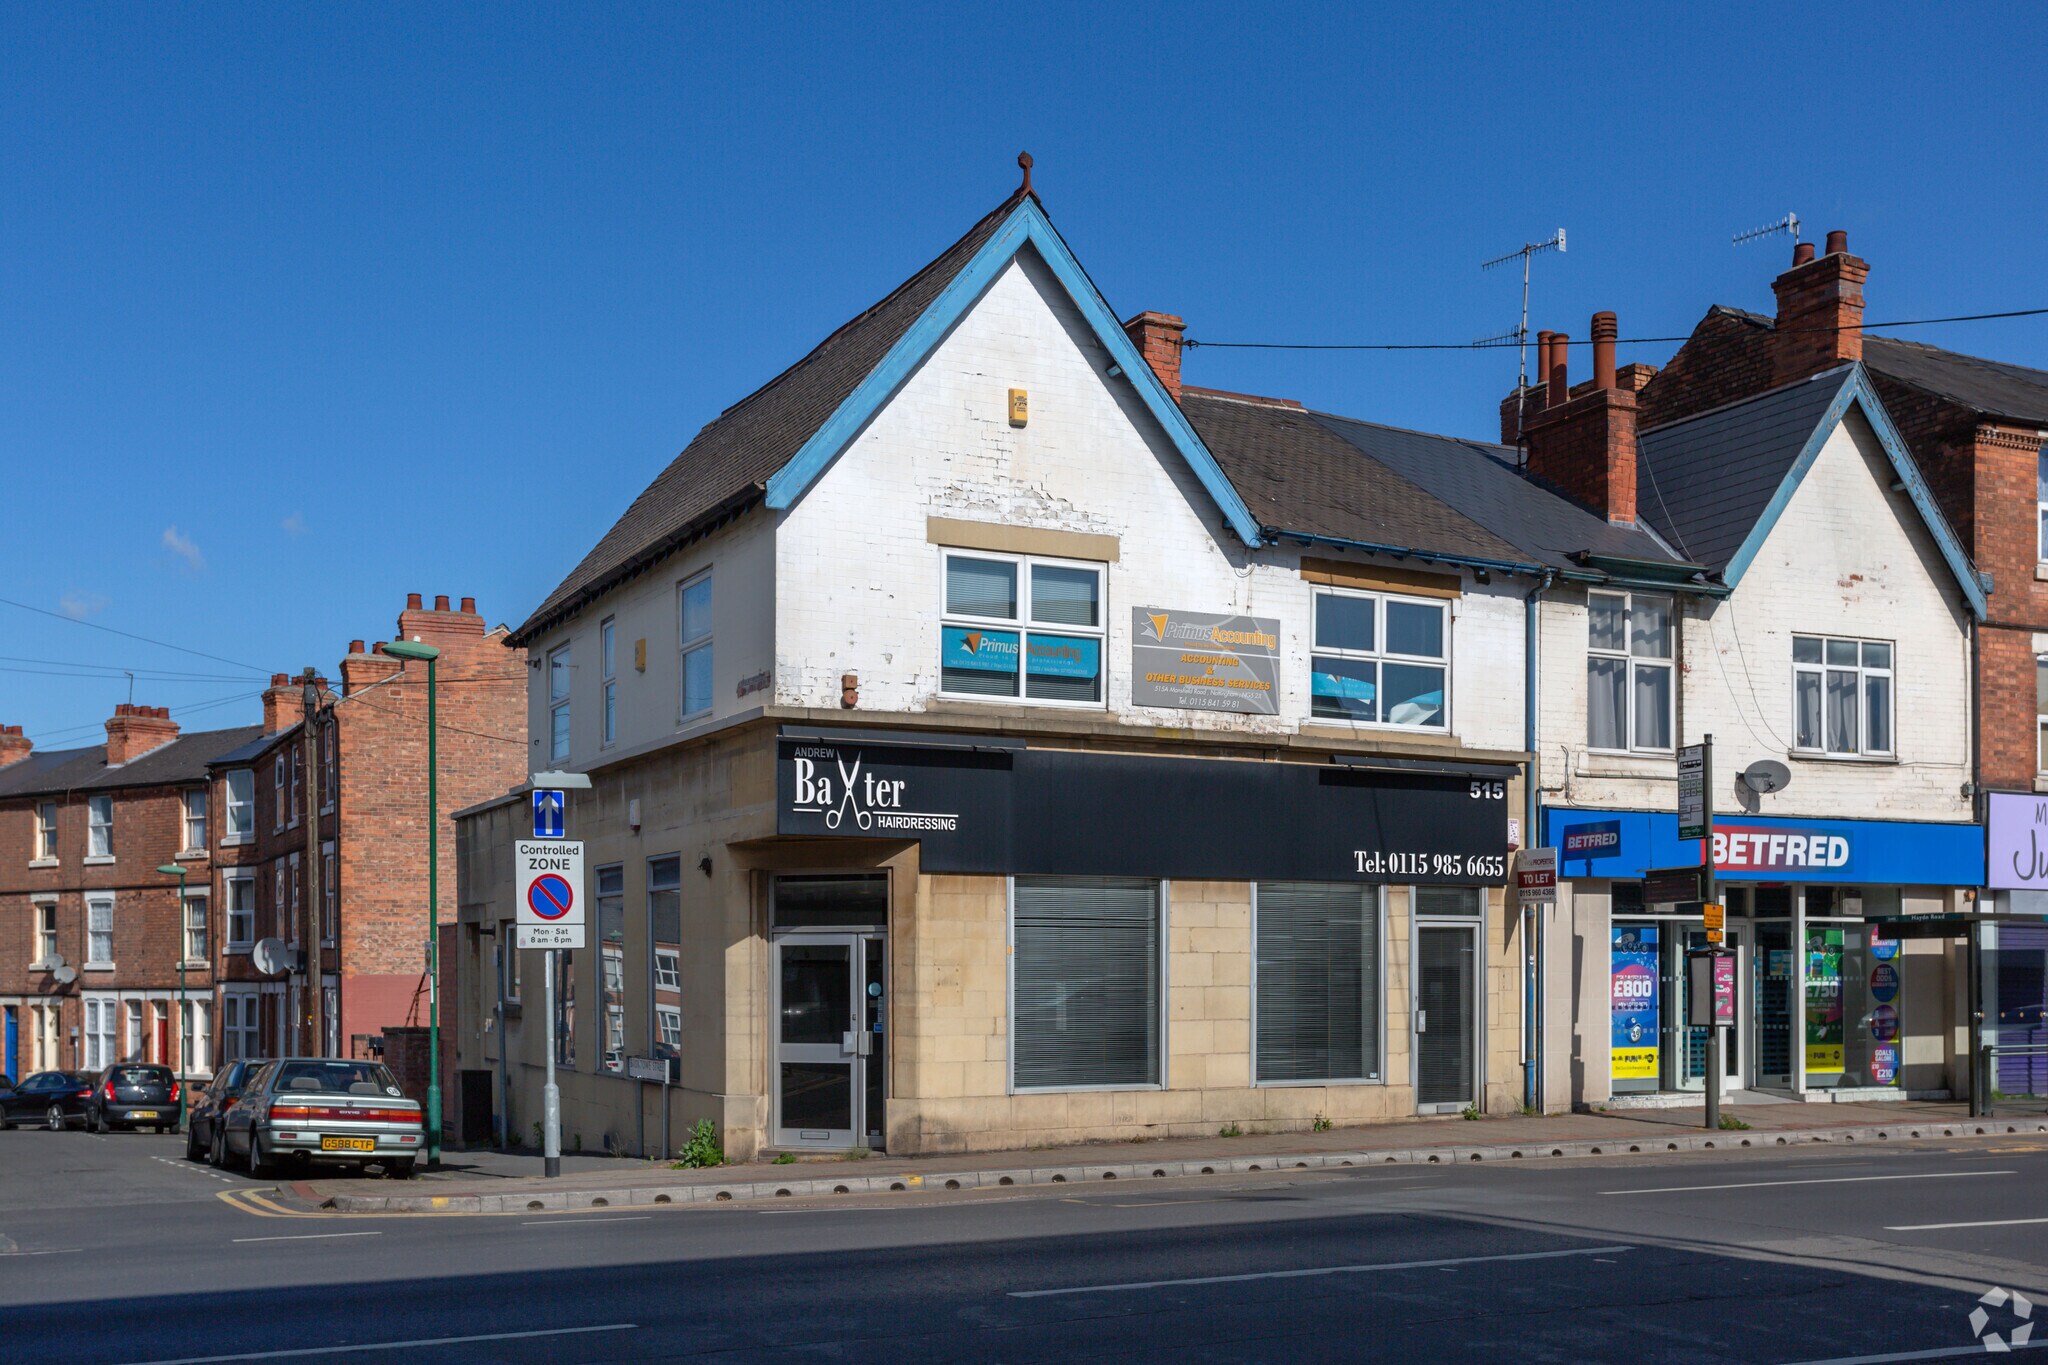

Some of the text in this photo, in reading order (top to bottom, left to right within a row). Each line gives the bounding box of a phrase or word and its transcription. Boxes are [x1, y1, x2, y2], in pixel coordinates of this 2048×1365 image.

[1181, 653, 1239, 667] ACCOUNTING
[1206, 666, 1214, 675] &
[1145, 672, 1271, 691] OTHER BUSINESS SERVICES
[1190, 697, 1207, 706] 0115
[794, 746, 835, 758] ANDREW
[1470, 781, 1504, 799] 515
[878, 815, 957, 831] HAIRDRESSING
[1567, 832, 1618, 849] BETFRED
[520, 844, 579, 855] Controlled
[1712, 832, 1850, 867] BETFRED
[529, 858, 571, 870] ZONE
[1354, 850, 1504, 877] Tel: 0115 985 6655
[1523, 873, 1550, 885] TO LET
[1613, 980, 1652, 997] £800
[1876, 1069, 1893, 1078] £210
[352, 1140, 374, 1149] CTF
